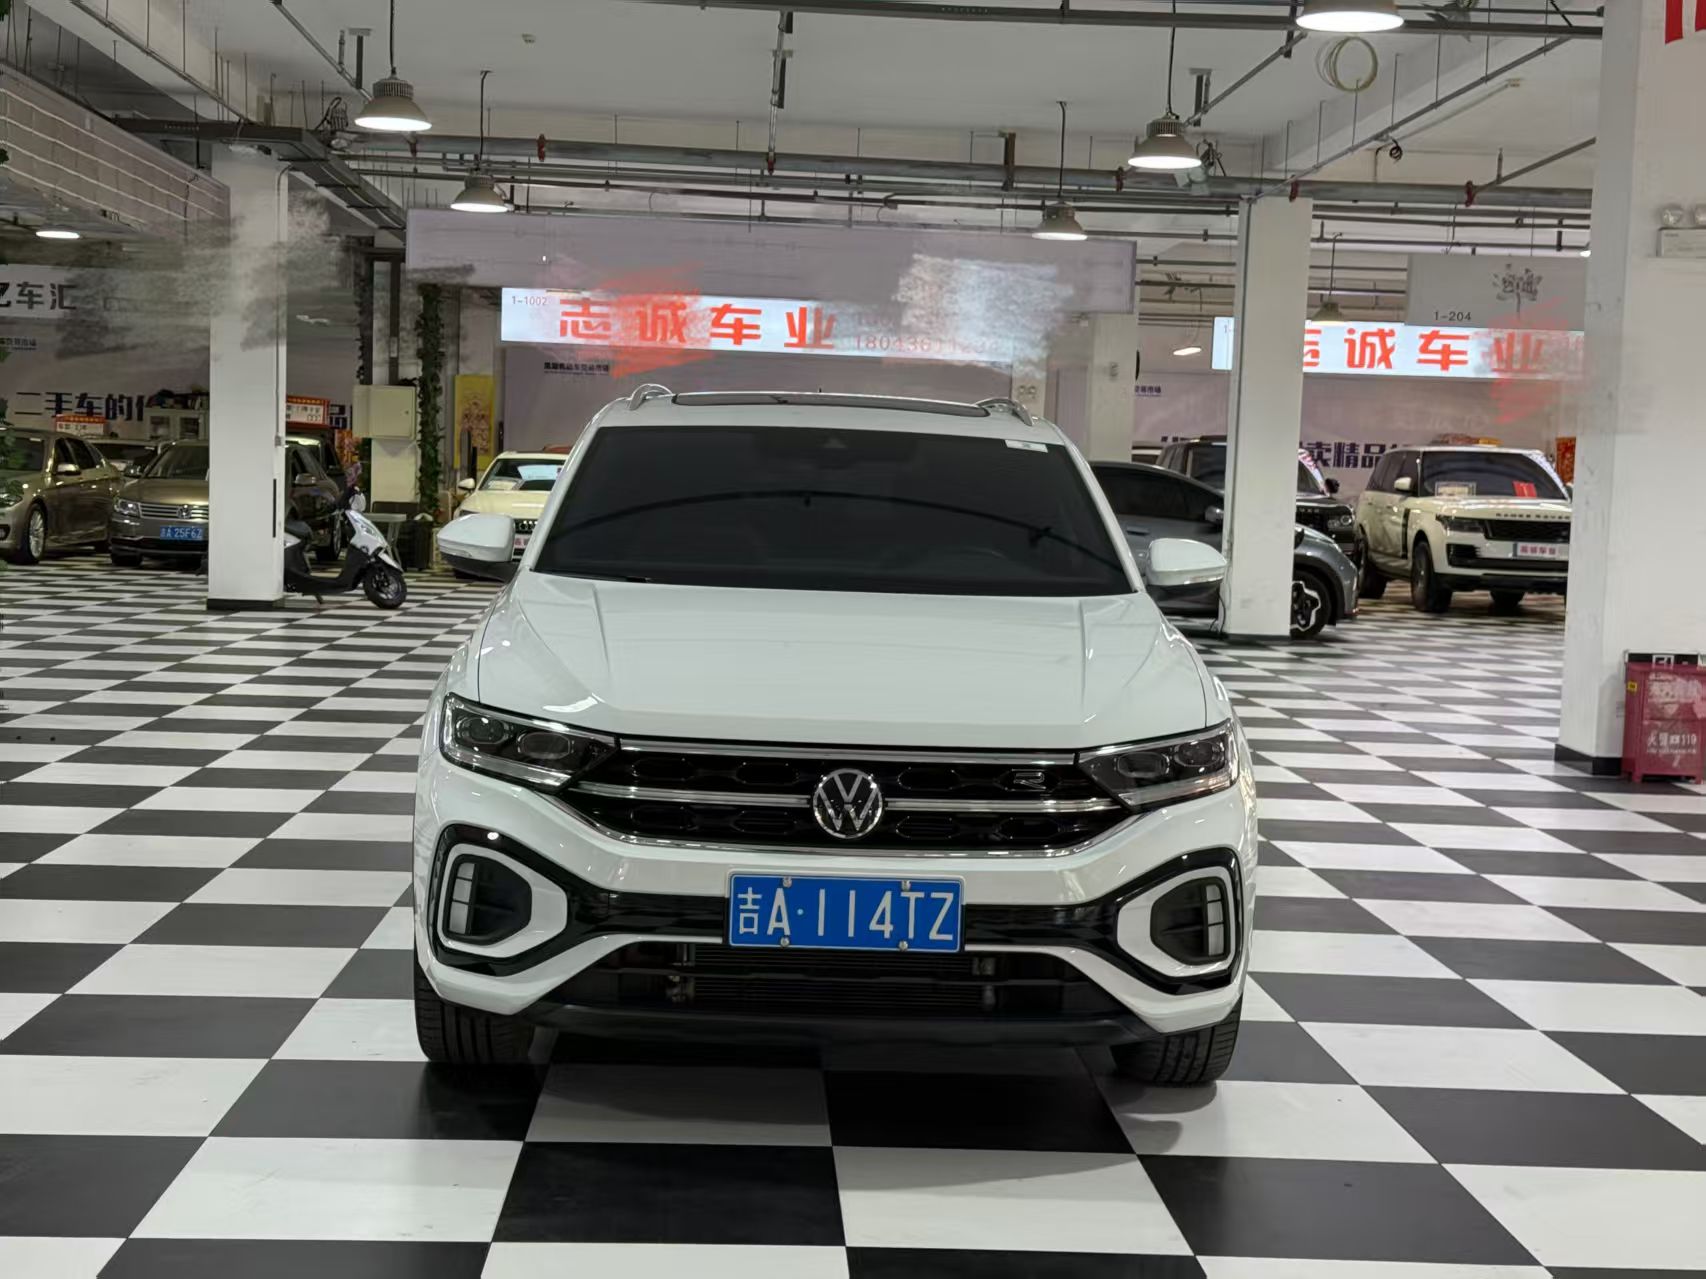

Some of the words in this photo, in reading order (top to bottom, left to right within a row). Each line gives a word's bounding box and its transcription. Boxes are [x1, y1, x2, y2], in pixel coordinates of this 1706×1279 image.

[512, 296, 547, 306] 1-1002
[560, 298, 837, 349] 志诚车业
[1434, 311, 1472, 322] 1-204
[1300, 442, 1398, 468] 卖精品
[737, 886, 955, 941] 吉A·114TZ
